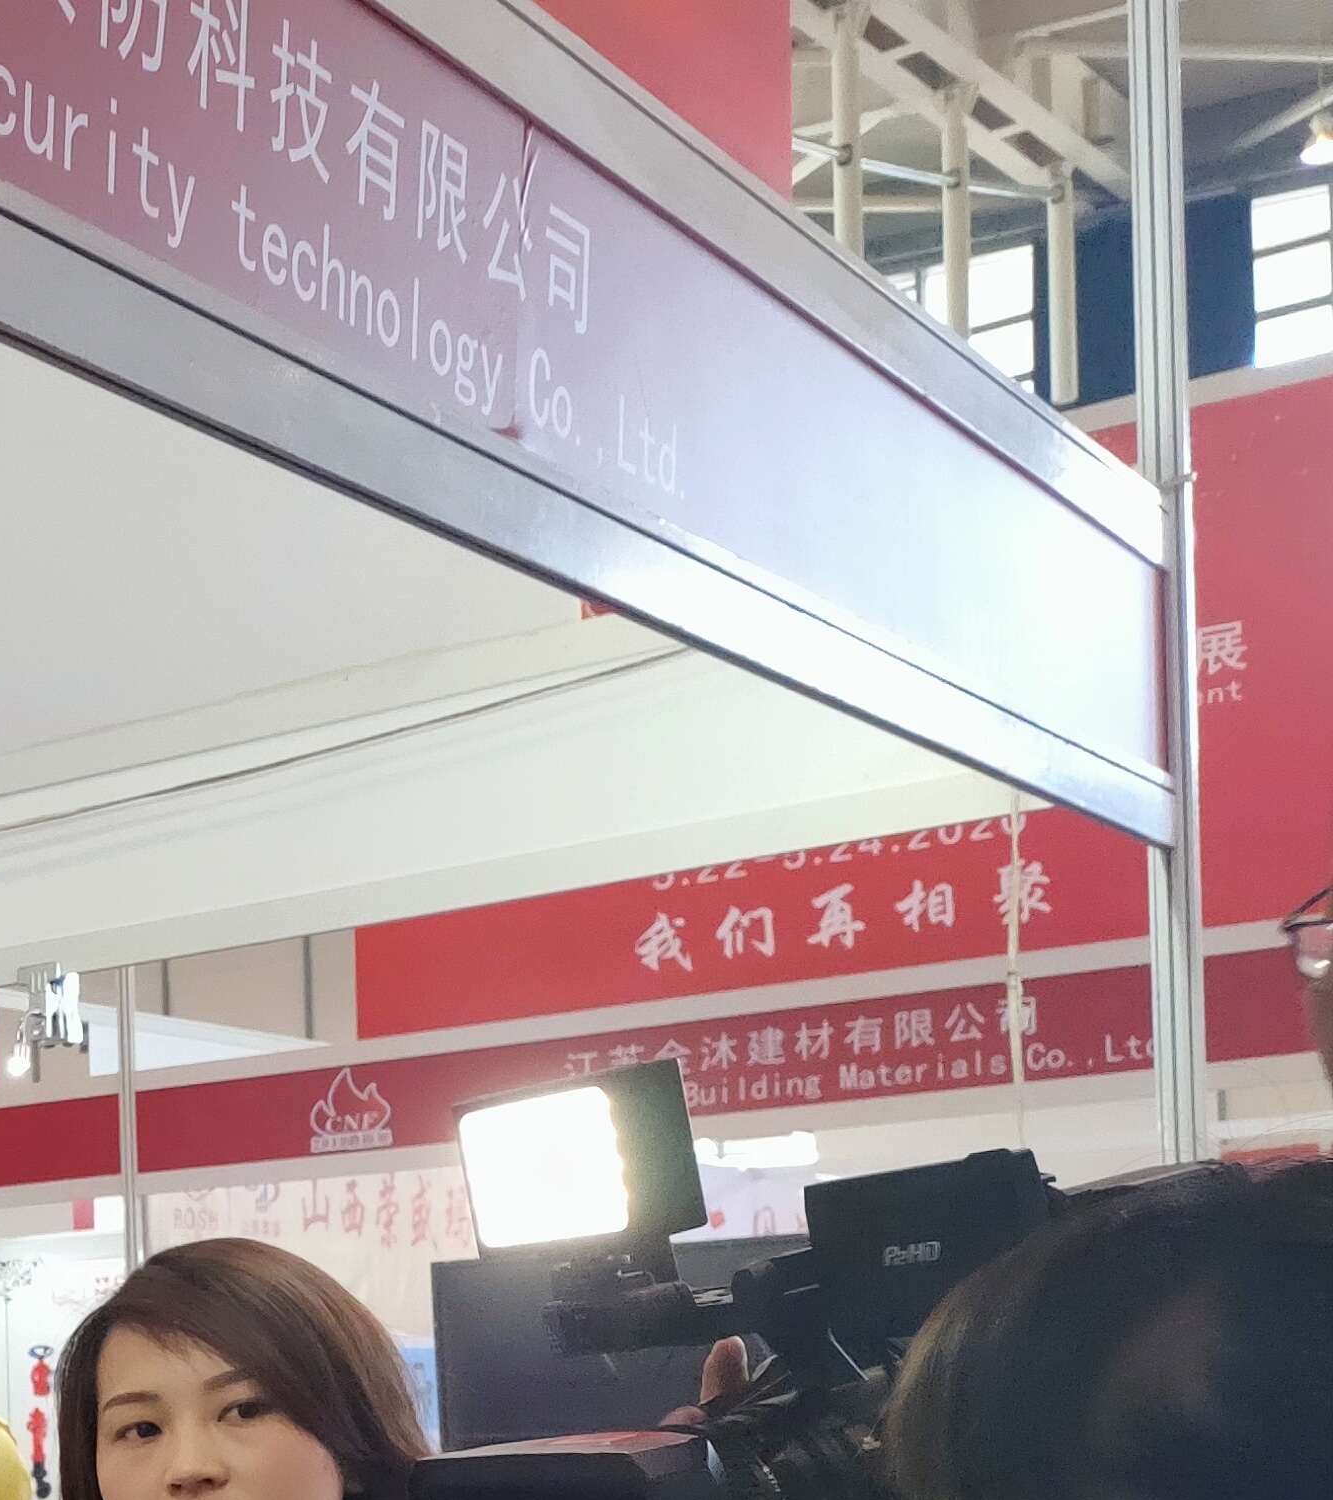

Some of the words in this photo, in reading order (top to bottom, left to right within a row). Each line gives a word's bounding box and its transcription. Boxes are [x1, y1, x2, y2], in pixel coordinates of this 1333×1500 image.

[232, 186, 503, 416] technology
[635, 860, 1053, 972] 我们再相聚
[839, 1050, 1007, 1091] Materials
